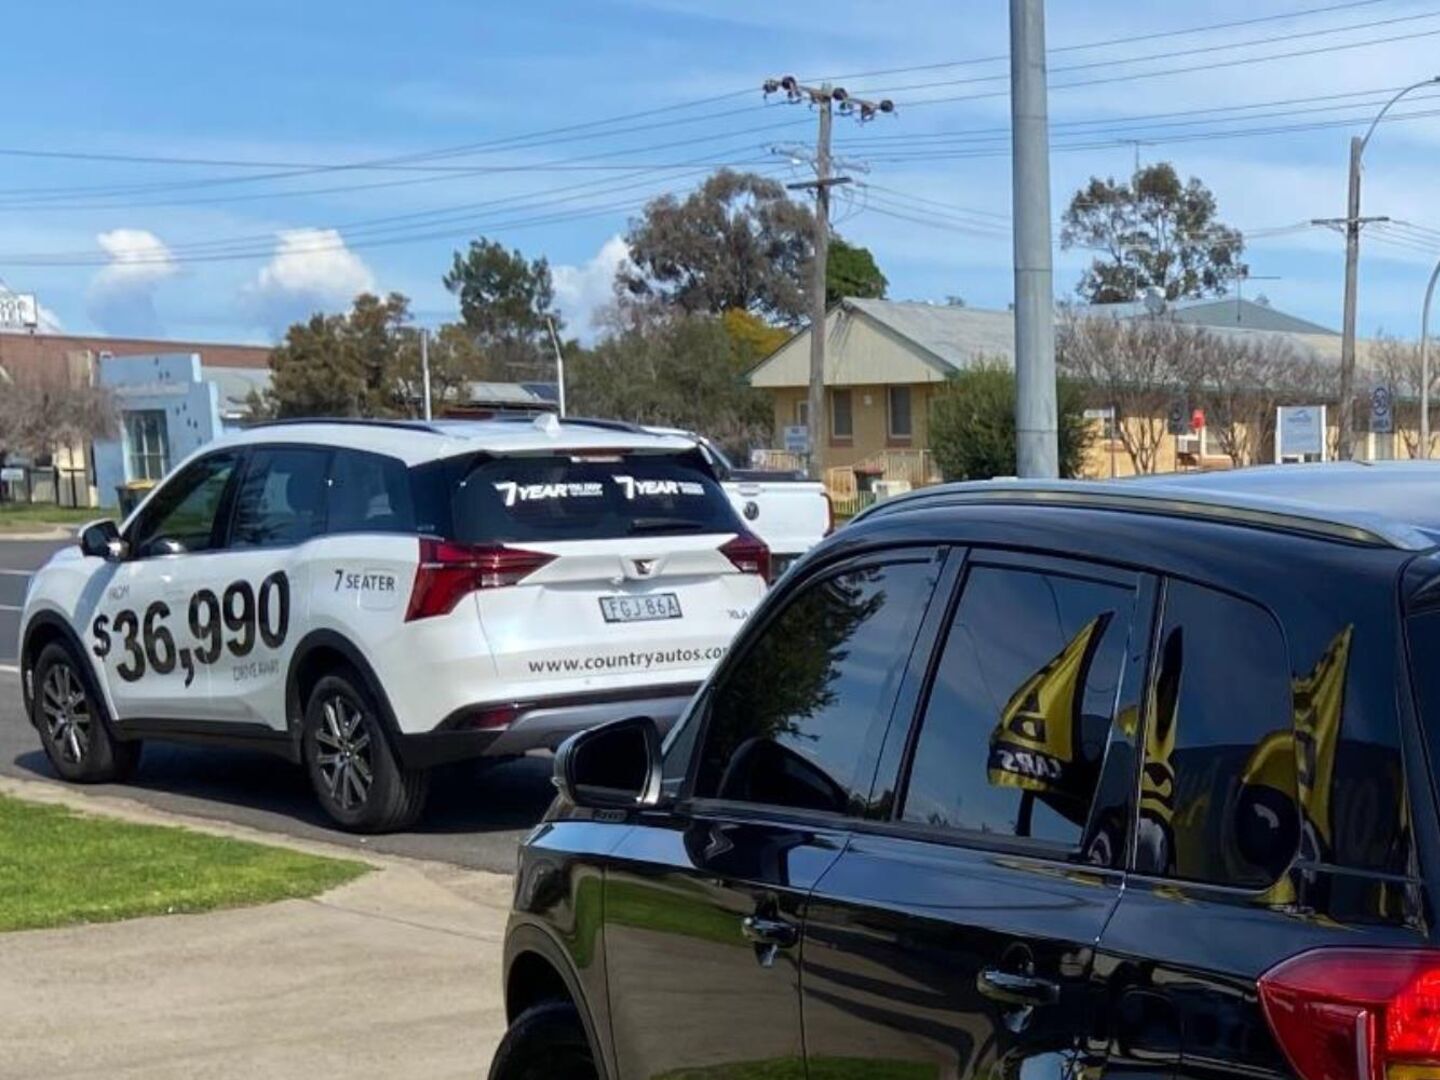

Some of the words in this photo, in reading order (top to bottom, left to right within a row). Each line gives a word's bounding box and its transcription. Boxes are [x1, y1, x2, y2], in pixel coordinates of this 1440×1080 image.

[494, 482, 517, 506] 7
[518, 483, 567, 501] YEAR
[613, 475, 634, 500] 7
[635, 479, 679, 496] YEAR
[334, 569, 344, 592] 7
[345, 571, 395, 592] SEATER
[92, 570, 290, 688] $36,990
